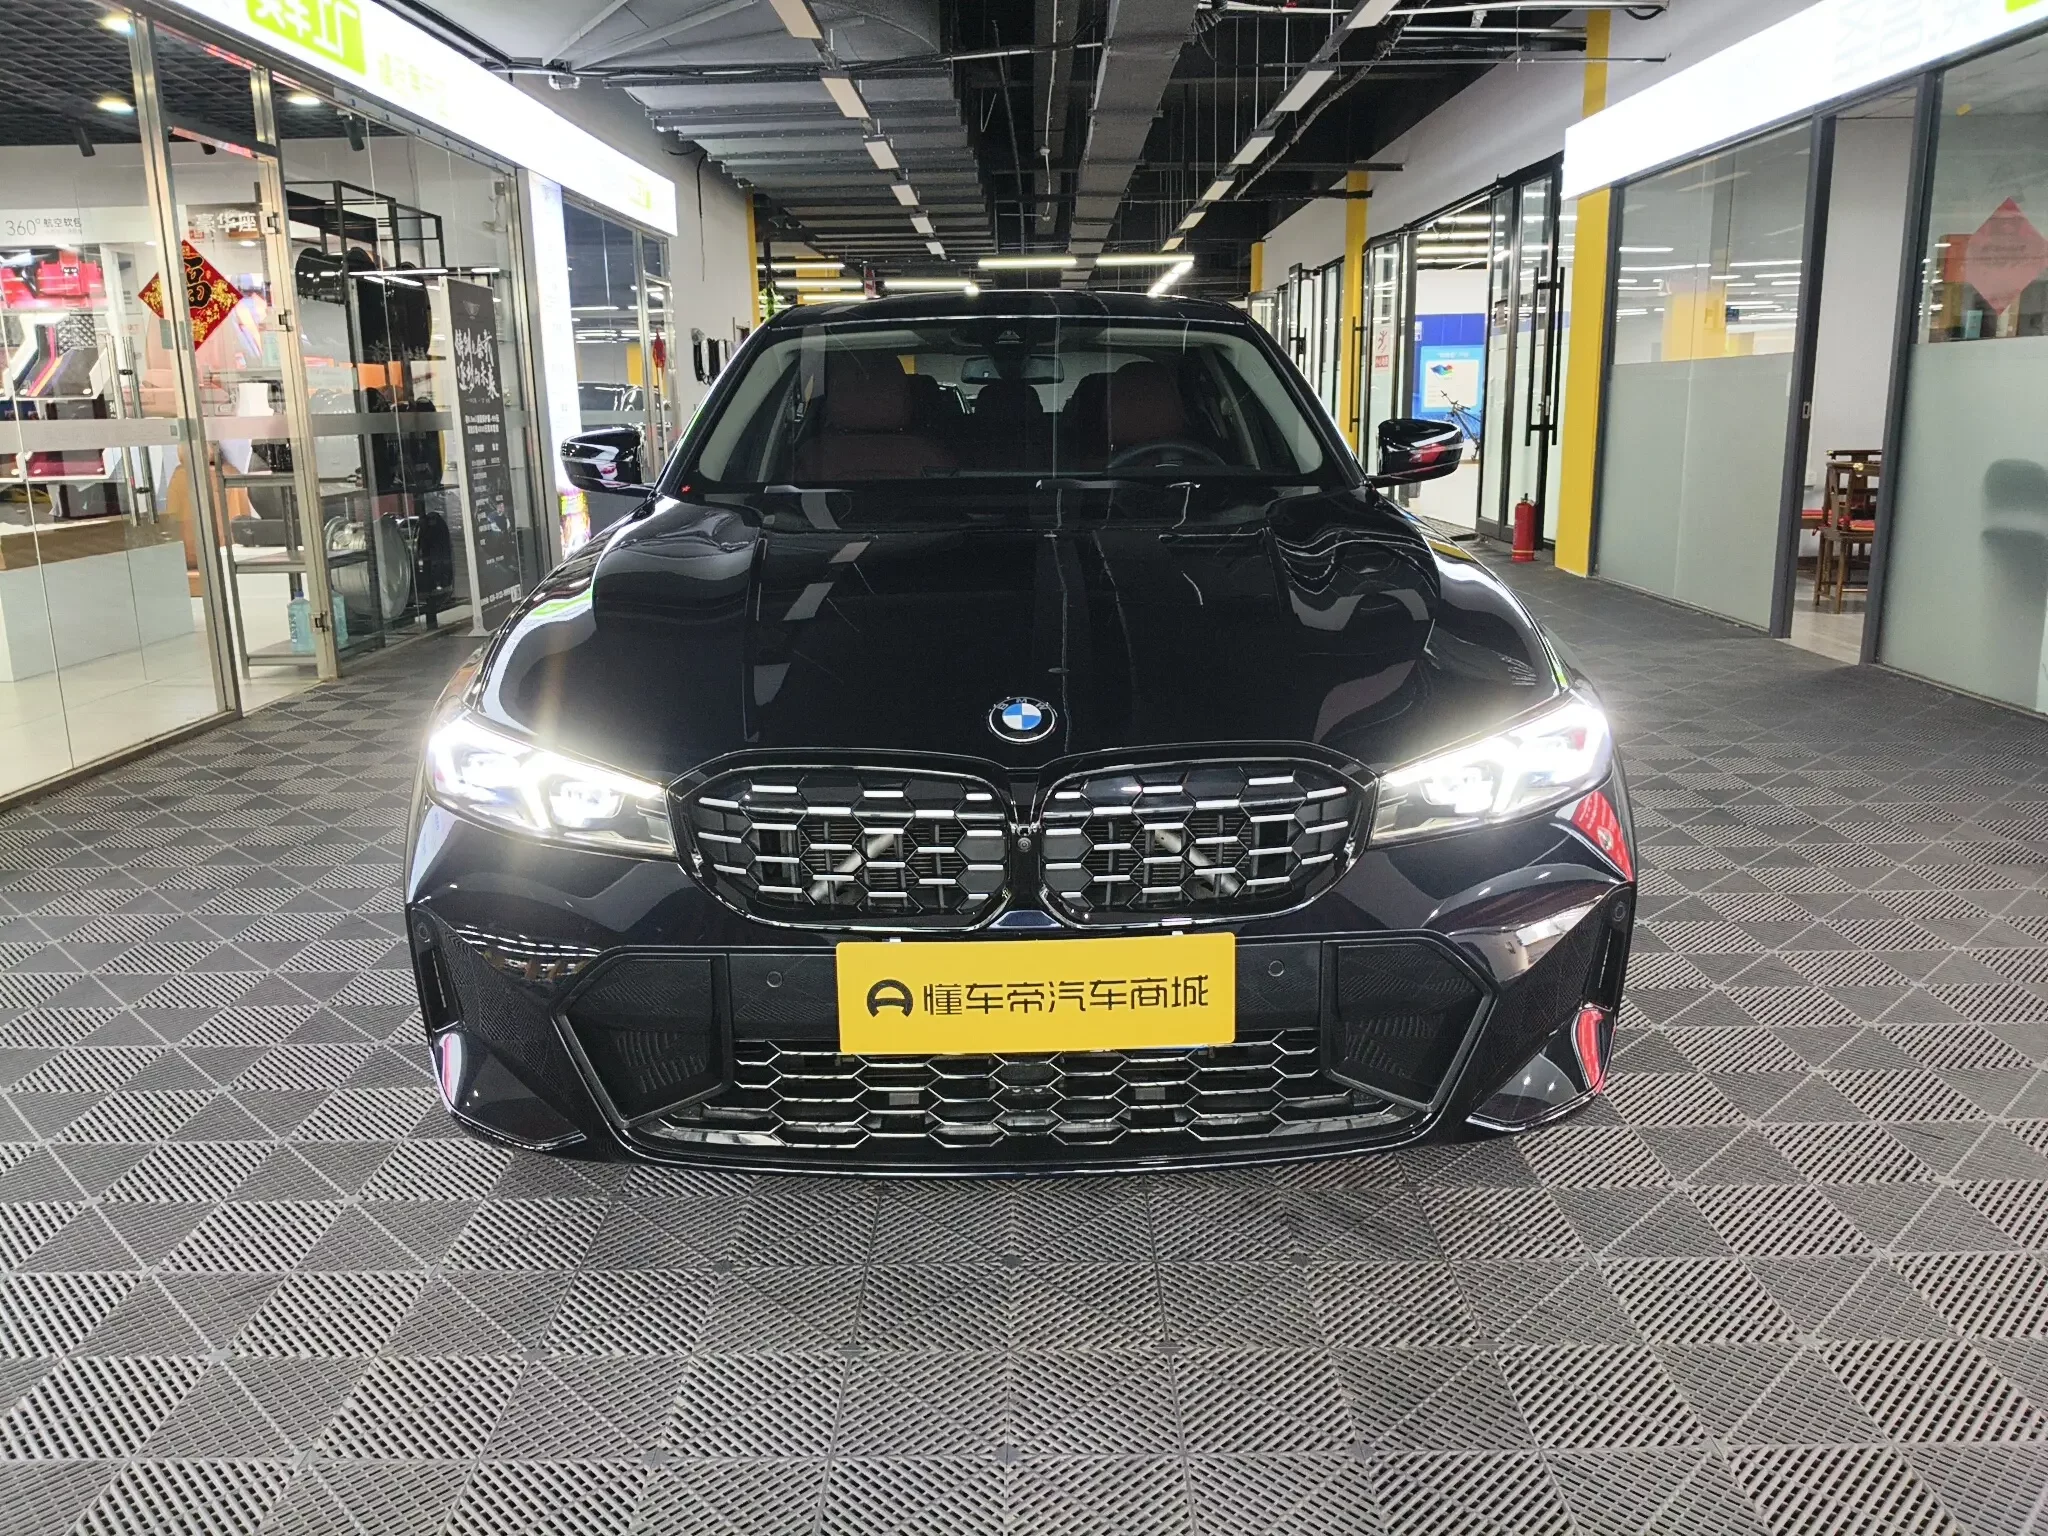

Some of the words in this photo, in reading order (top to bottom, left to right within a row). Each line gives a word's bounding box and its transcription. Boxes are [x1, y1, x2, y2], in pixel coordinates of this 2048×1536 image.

[996, 698, 1048, 710] BMW
[923, 974, 1209, 1016] 懂车帝汽车商城
